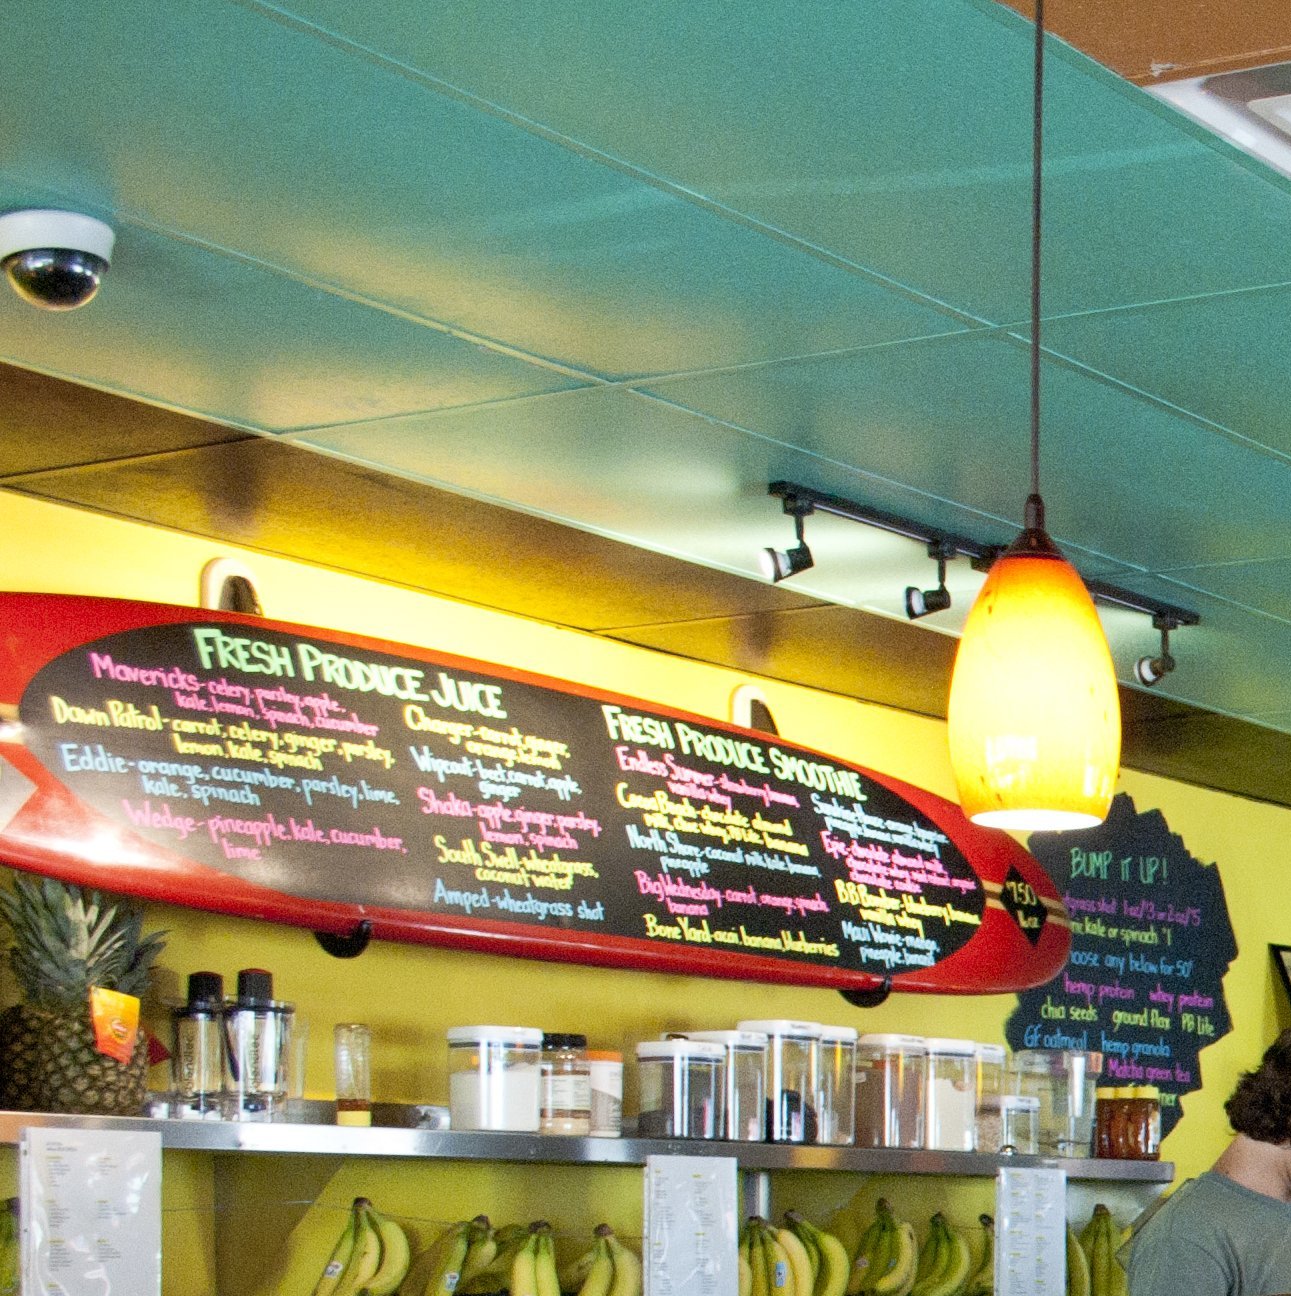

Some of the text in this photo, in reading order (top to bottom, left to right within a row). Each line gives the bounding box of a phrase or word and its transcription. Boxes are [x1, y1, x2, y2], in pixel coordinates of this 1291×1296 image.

[193, 628, 507, 719] FRESH PRODUCE JUICE
[602, 705, 867, 801] FRESH PRODUCE SMOOTHIE
[1070, 847, 1112, 879] BUMP
